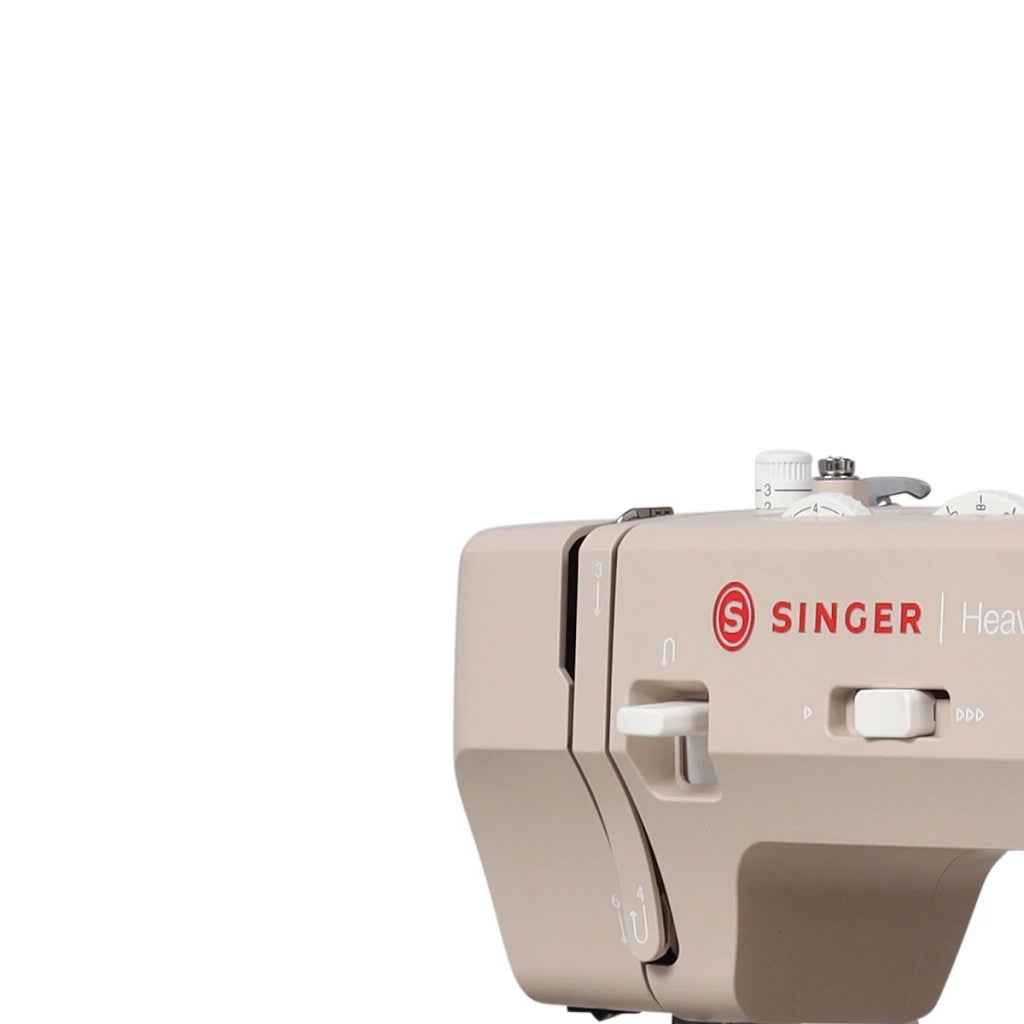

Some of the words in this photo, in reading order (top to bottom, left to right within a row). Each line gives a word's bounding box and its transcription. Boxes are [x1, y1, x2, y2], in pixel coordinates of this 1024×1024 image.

[763, 483, 772, 497] 3
[812, 502, 819, 513] 4
[594, 561, 603, 578] 3
[771, 600, 923, 635] SINGER
[636, 884, 646, 902] 4
